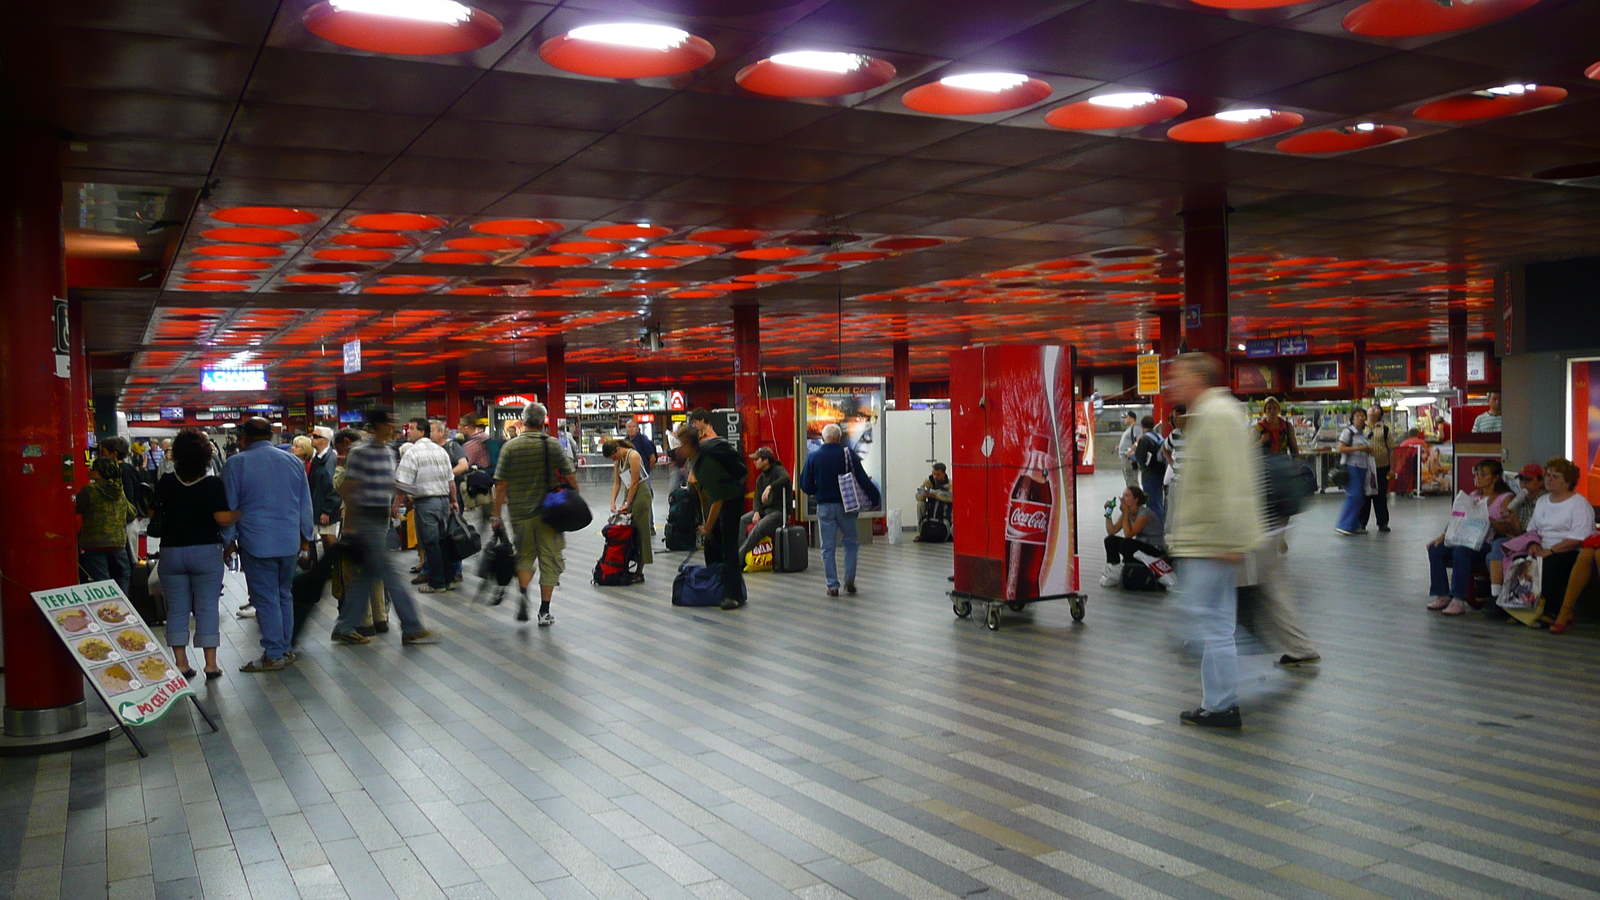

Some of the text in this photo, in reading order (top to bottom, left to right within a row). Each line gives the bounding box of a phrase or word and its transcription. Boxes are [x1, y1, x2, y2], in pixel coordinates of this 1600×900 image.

[808, 386, 851, 394] NICOLAS
[41, 585, 120, 608] TEPLÁ JÍDLA
[137, 678, 187, 715] PO CELÝ DEN
